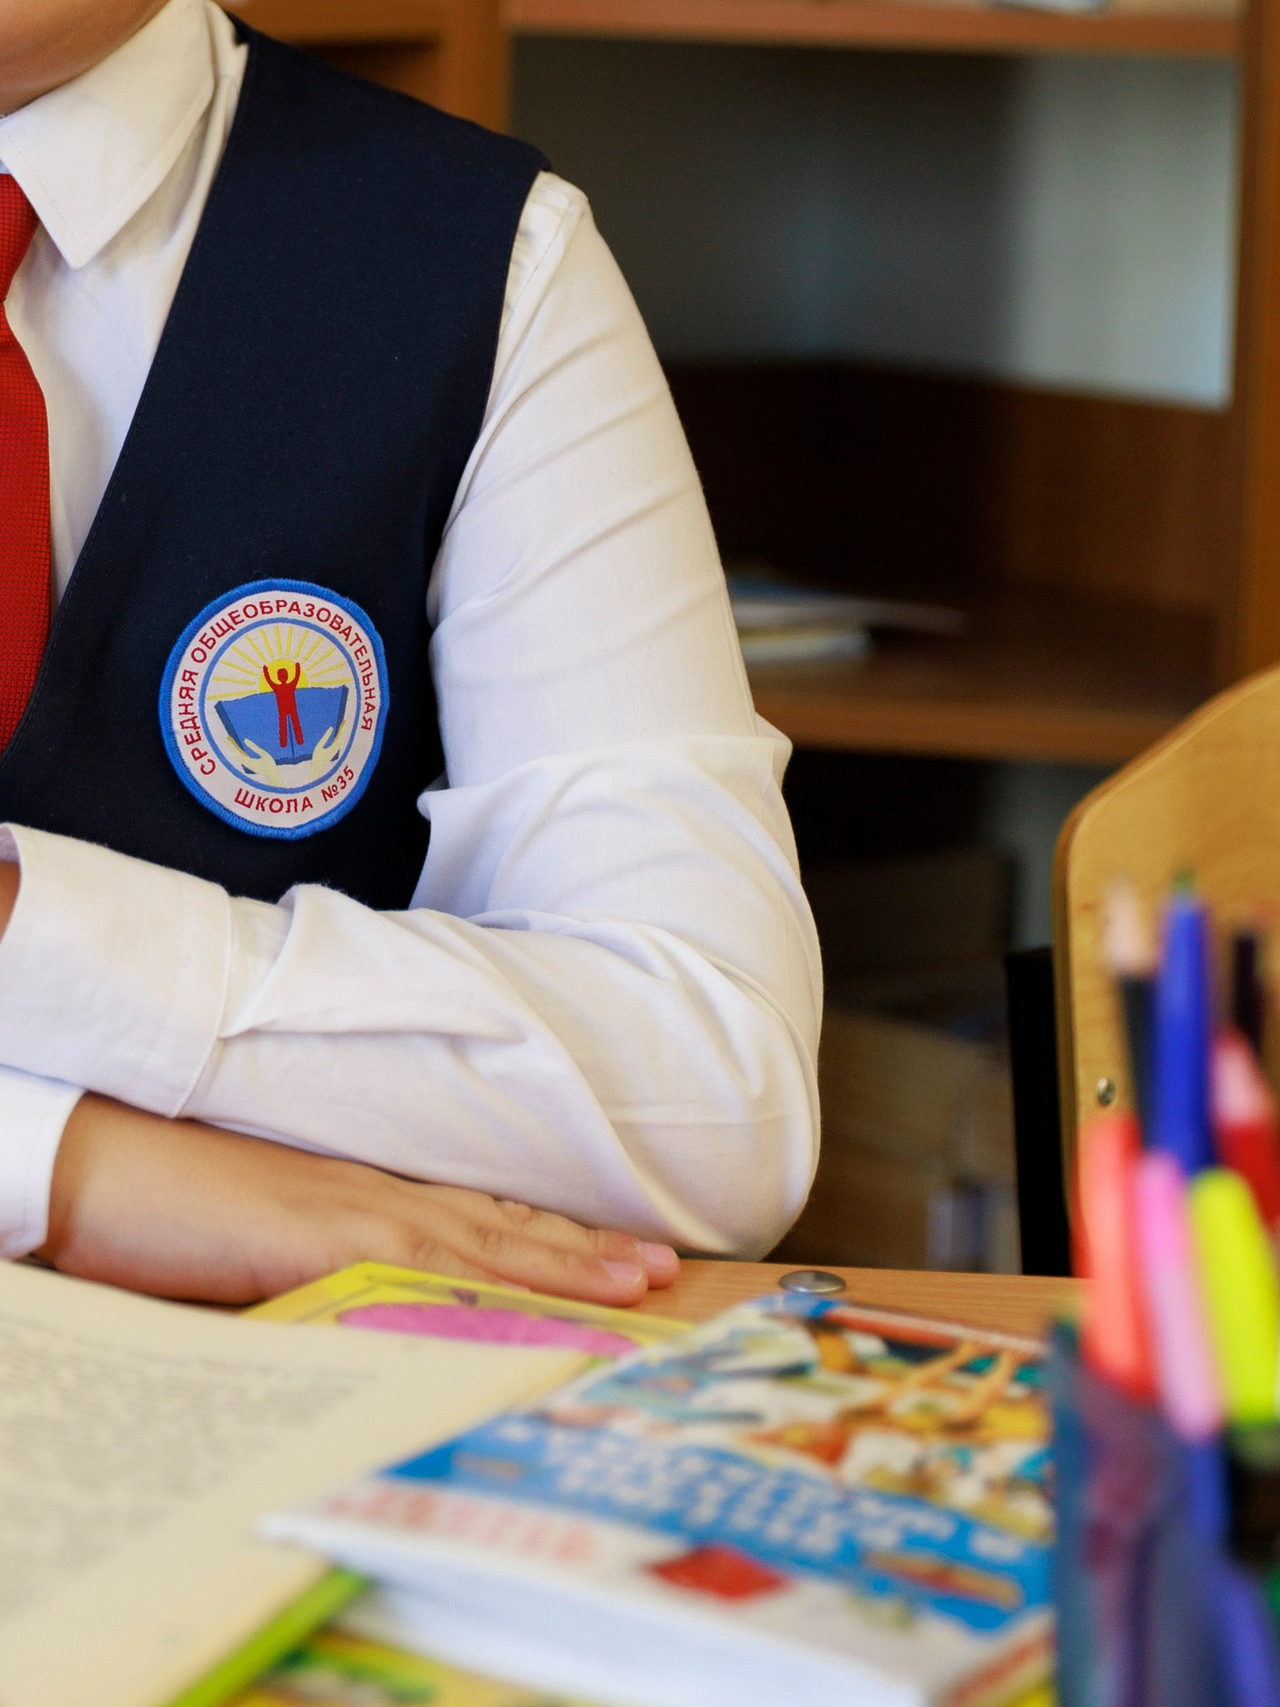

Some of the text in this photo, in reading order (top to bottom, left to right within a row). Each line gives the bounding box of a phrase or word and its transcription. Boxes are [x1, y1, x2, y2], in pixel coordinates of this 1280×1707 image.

[178, 599, 376, 776] СРЕДНЯЯ ОБЩЕОБРАЗОВАТЕЛЬНАЯ
[234, 787, 313, 814] ШКОЛА
